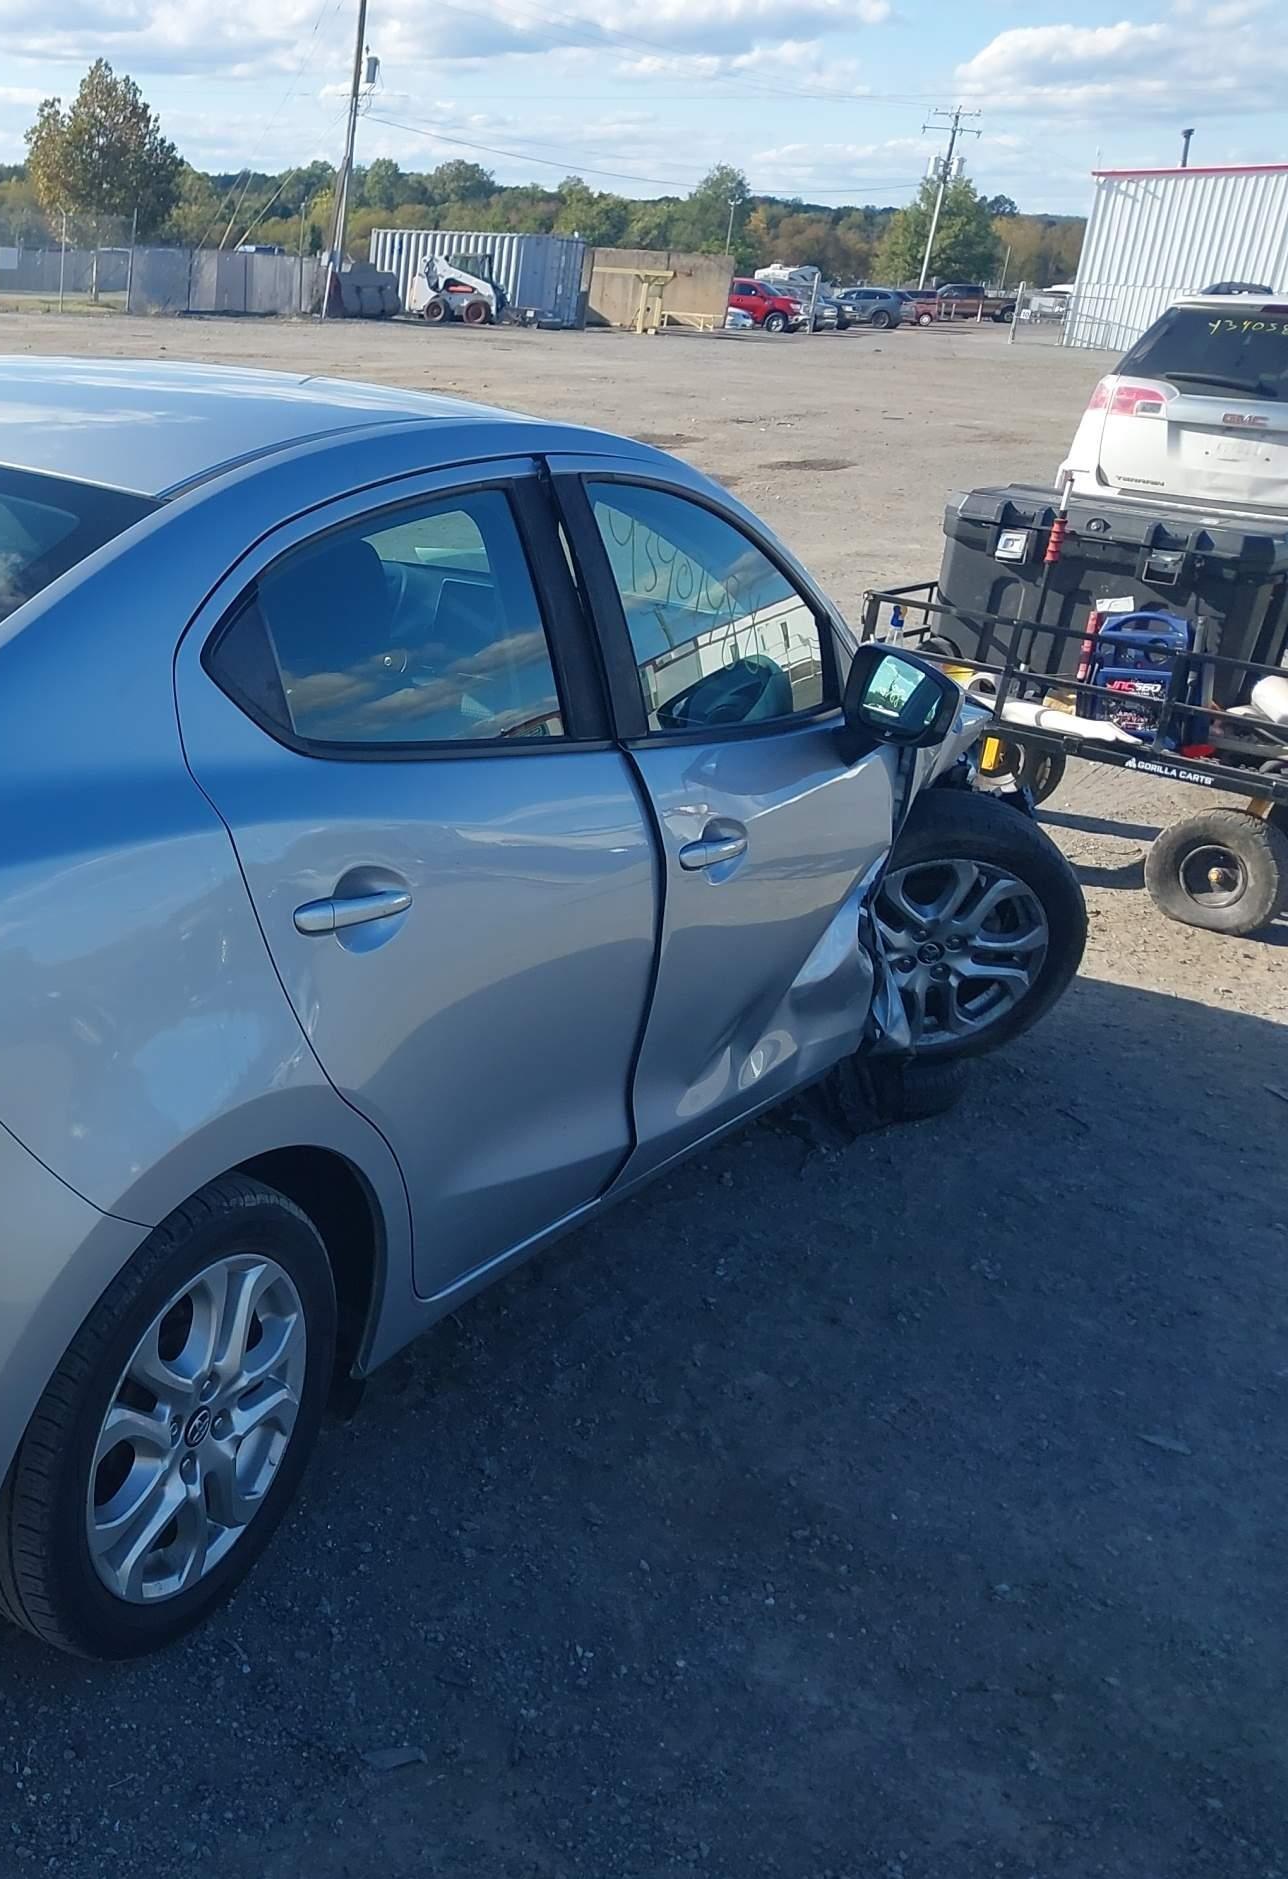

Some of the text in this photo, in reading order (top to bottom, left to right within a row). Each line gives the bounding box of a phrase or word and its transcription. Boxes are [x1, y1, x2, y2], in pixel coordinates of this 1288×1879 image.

[1223, 413, 1270, 427] GMC
[1137, 761, 1212, 785] GORILLA CARTS
